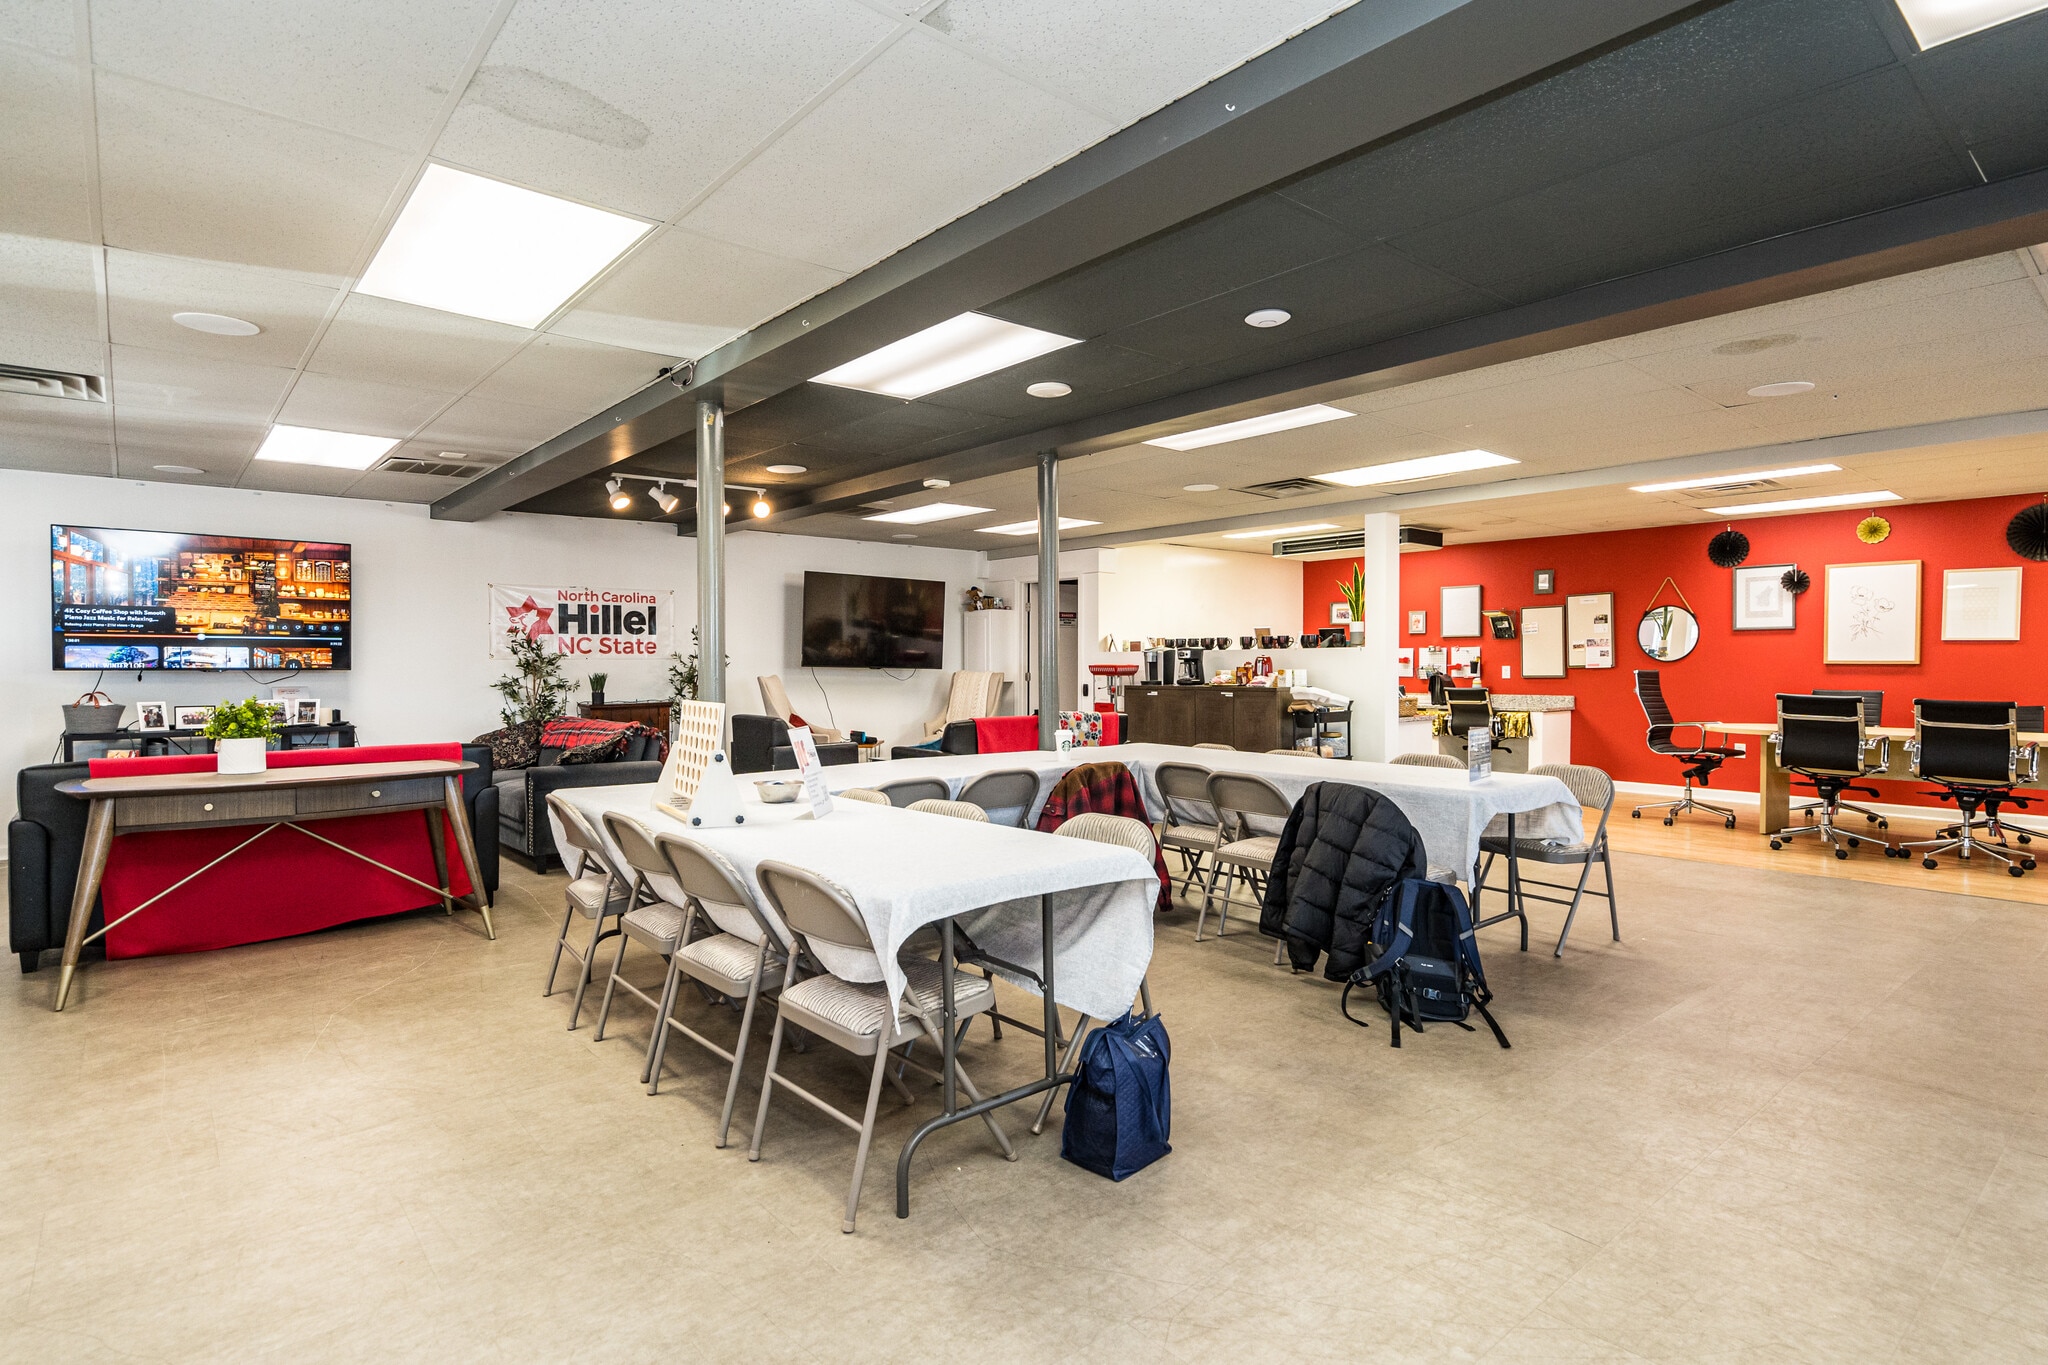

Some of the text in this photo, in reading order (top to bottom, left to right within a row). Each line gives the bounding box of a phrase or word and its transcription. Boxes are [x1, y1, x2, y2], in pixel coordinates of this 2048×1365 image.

[557, 590, 657, 604] North Carolina
[558, 603, 657, 635] Hillel
[558, 636, 657, 655] NC State
